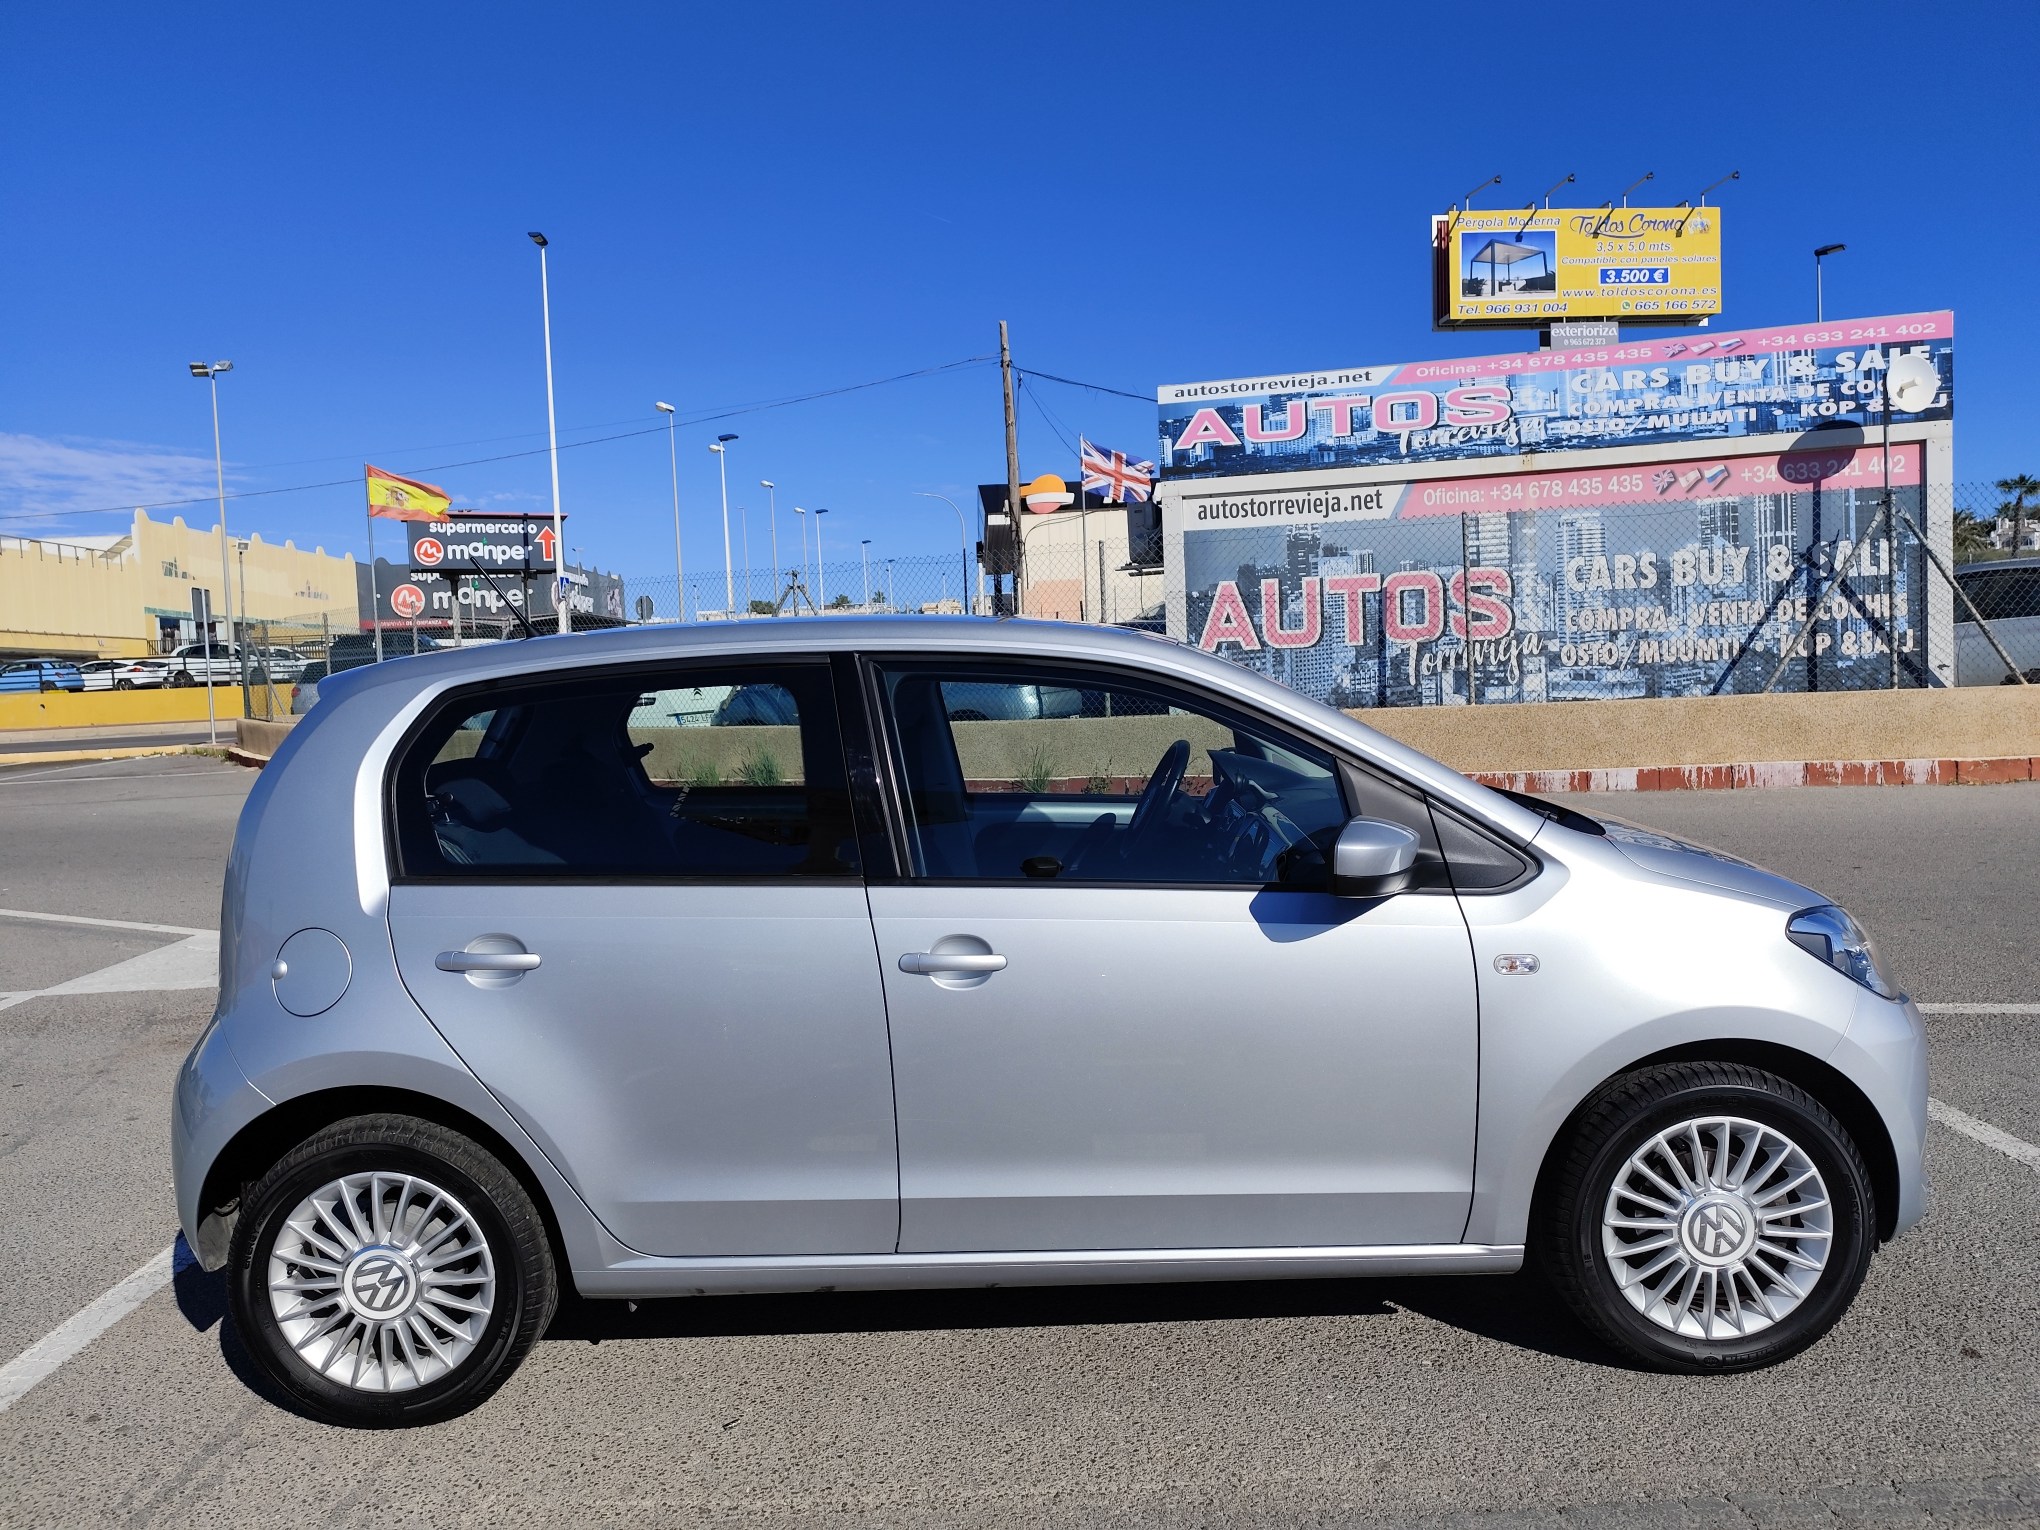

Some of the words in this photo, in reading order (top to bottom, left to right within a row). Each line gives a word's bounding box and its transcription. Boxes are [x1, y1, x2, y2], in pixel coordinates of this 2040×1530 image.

[1508, 215, 1561, 227] Moderna
[1570, 214, 1624, 238] Toldos
[1629, 213, 1685, 233] Corona
[1561, 256, 1617, 266] Compatible
[1641, 256, 1679, 265] paneles
[1682, 254, 1717, 263] solares
[1605, 269, 1650, 283] 3.500
[1653, 269, 1665, 282] €
[1562, 286, 1717, 297] www.toldoscorona.es
[1485, 303, 1511, 314] 966
[1514, 303, 1538, 313] 931
[1542, 302, 1568, 312] 004
[1635, 300, 1660, 310] 665
[1665, 300, 1688, 310] 166
[1691, 299, 1716, 310] 572
[1551, 324, 1618, 337] exterioriza
[1758, 335, 1798, 347] +34
[1803, 331, 1844, 343] 633
[1850, 326, 1890, 339] 241
[1895, 322, 1936, 335] 402
[1416, 364, 1482, 378] Oficina:
[1487, 358, 1524, 370] +34
[1528, 354, 1566, 368] 678
[1571, 351, 1609, 363] 435
[1614, 347, 1653, 360] 435
[1571, 367, 1670, 394] CARS
[1686, 358, 1770, 386] BUY
[1788, 355, 1818, 377] &
[1174, 370, 1373, 398] autostorrevieja.net
[1569, 395, 1680, 416] COMPRA
[1705, 385, 1788, 406] VENTA
[1800, 382, 1830, 398] DE
[1800, 398, 1856, 418] KÖP
[1173, 385, 1512, 452] AUTOS
[1740, 464, 1778, 484] +34
[1783, 461, 1821, 481] 633
[1826, 457, 1863, 477] 241
[1423, 487, 1485, 506] Oficina:
[1489, 485, 1524, 501] +34
[1528, 481, 1563, 499] 678
[1568, 478, 1603, 496] 435
[1607, 474, 1644, 493] 435
[1196, 489, 1384, 521] autostorrevieja.net
[429, 522, 538, 536] supermercado
[447, 541, 534, 565] manper
[1566, 552, 1658, 593] CARS
[1673, 546, 1750, 587] BUY
[1766, 543, 1796, 582] &
[1198, 565, 1514, 653] AUTOS
[1566, 605, 1669, 633] COMPRA
[1687, 599, 1766, 629] VENTA
[1777, 597, 1807, 622] DE
